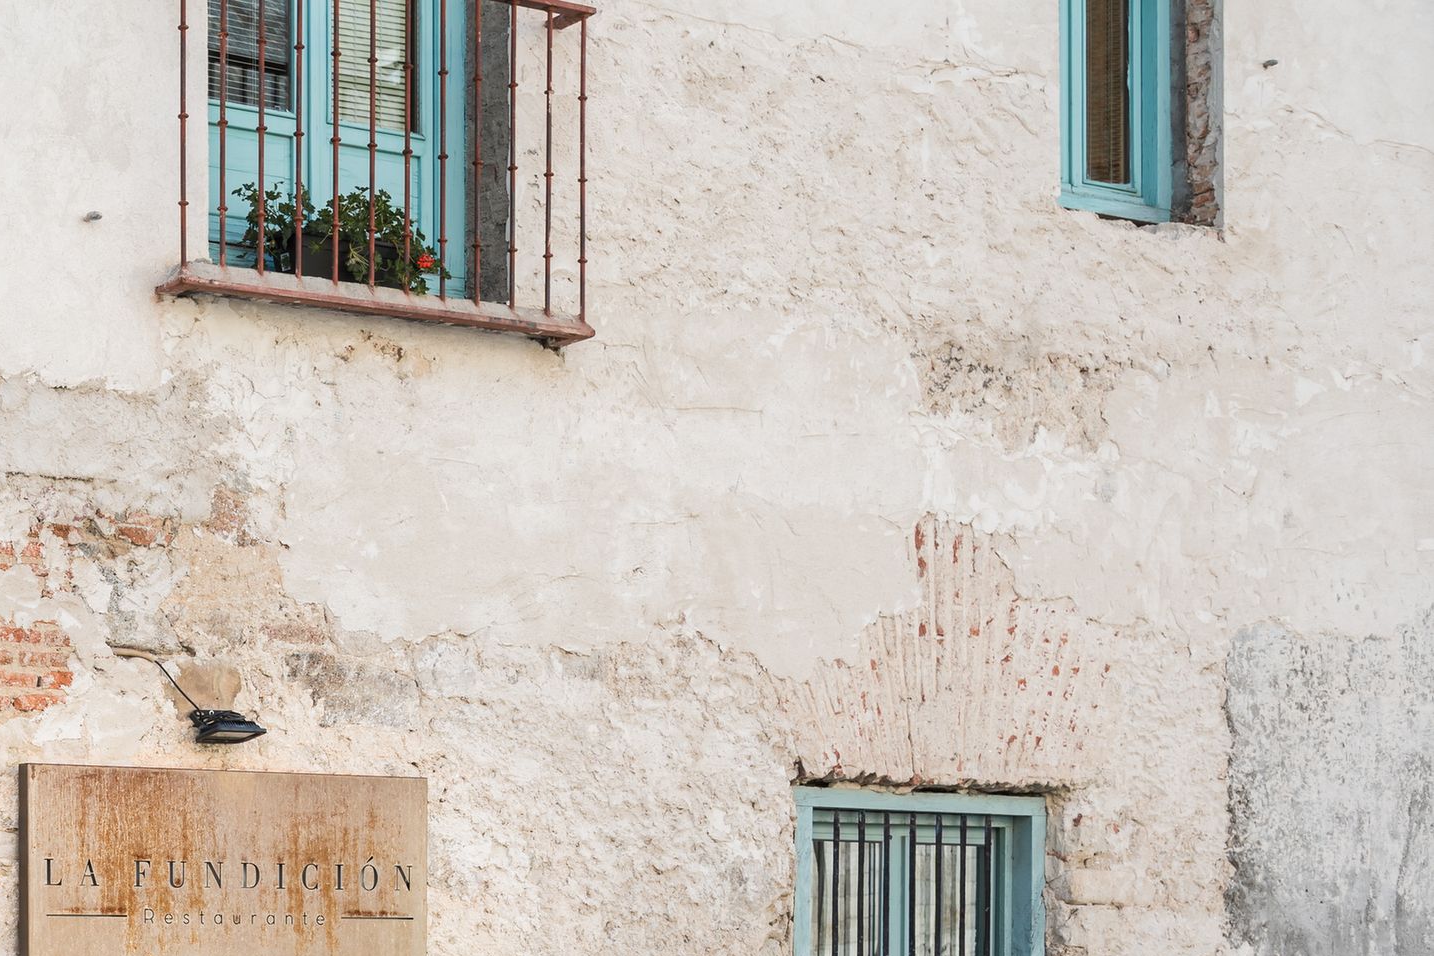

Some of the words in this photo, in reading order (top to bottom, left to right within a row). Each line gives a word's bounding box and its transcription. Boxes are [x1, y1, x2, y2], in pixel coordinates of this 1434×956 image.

[43, 857, 100, 887] LA
[132, 855, 414, 892] FUNDICIÓN
[143, 907, 327, 927] Restaurante
